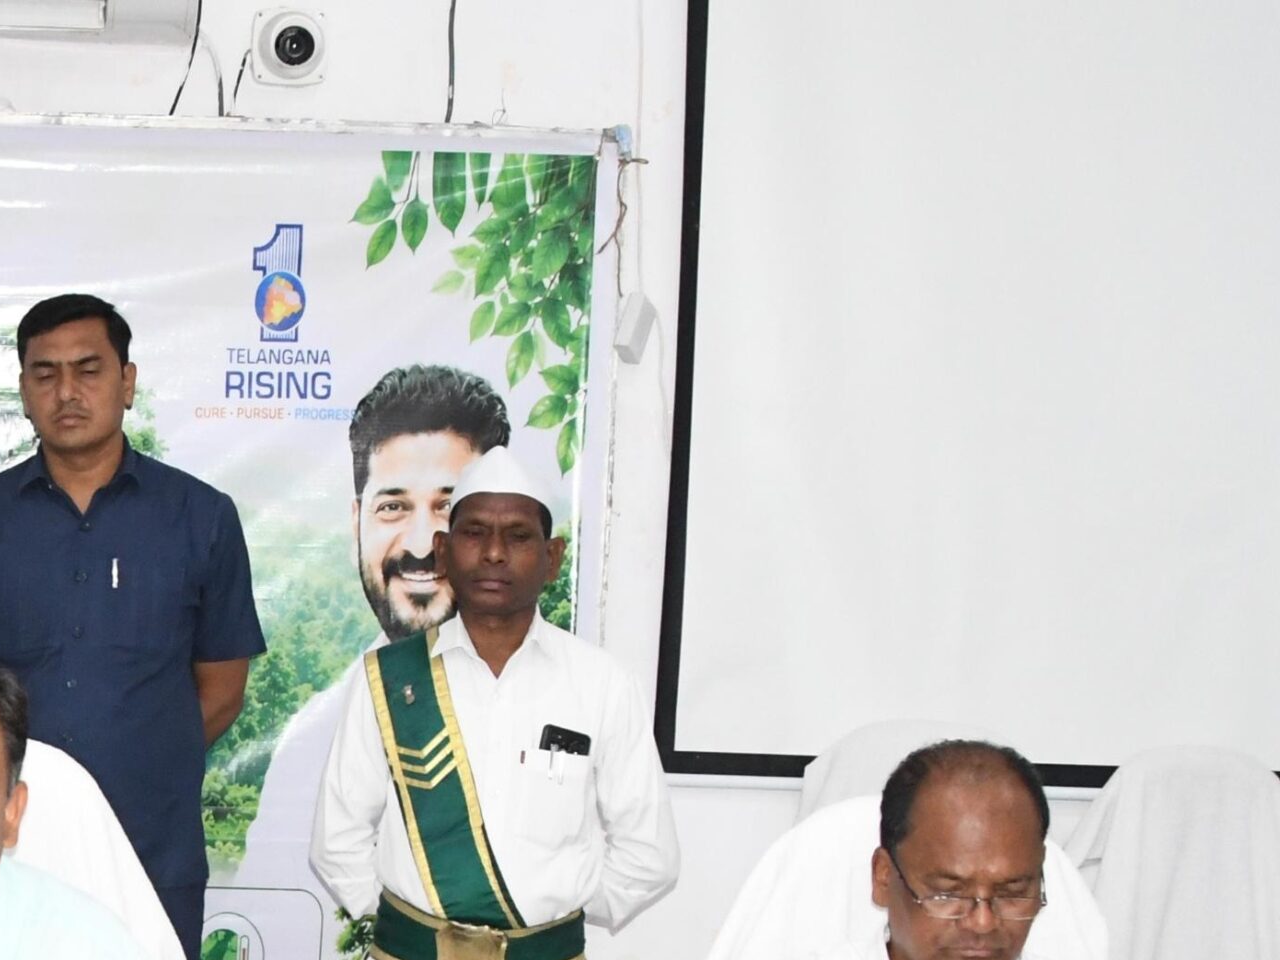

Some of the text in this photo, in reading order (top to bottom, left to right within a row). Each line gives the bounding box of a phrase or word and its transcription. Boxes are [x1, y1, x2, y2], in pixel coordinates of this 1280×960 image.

[226, 347, 331, 365] TELANGANA
[224, 370, 332, 401] RISING
[194, 406, 227, 420] CURE
[236, 407, 285, 420] PURSUE
